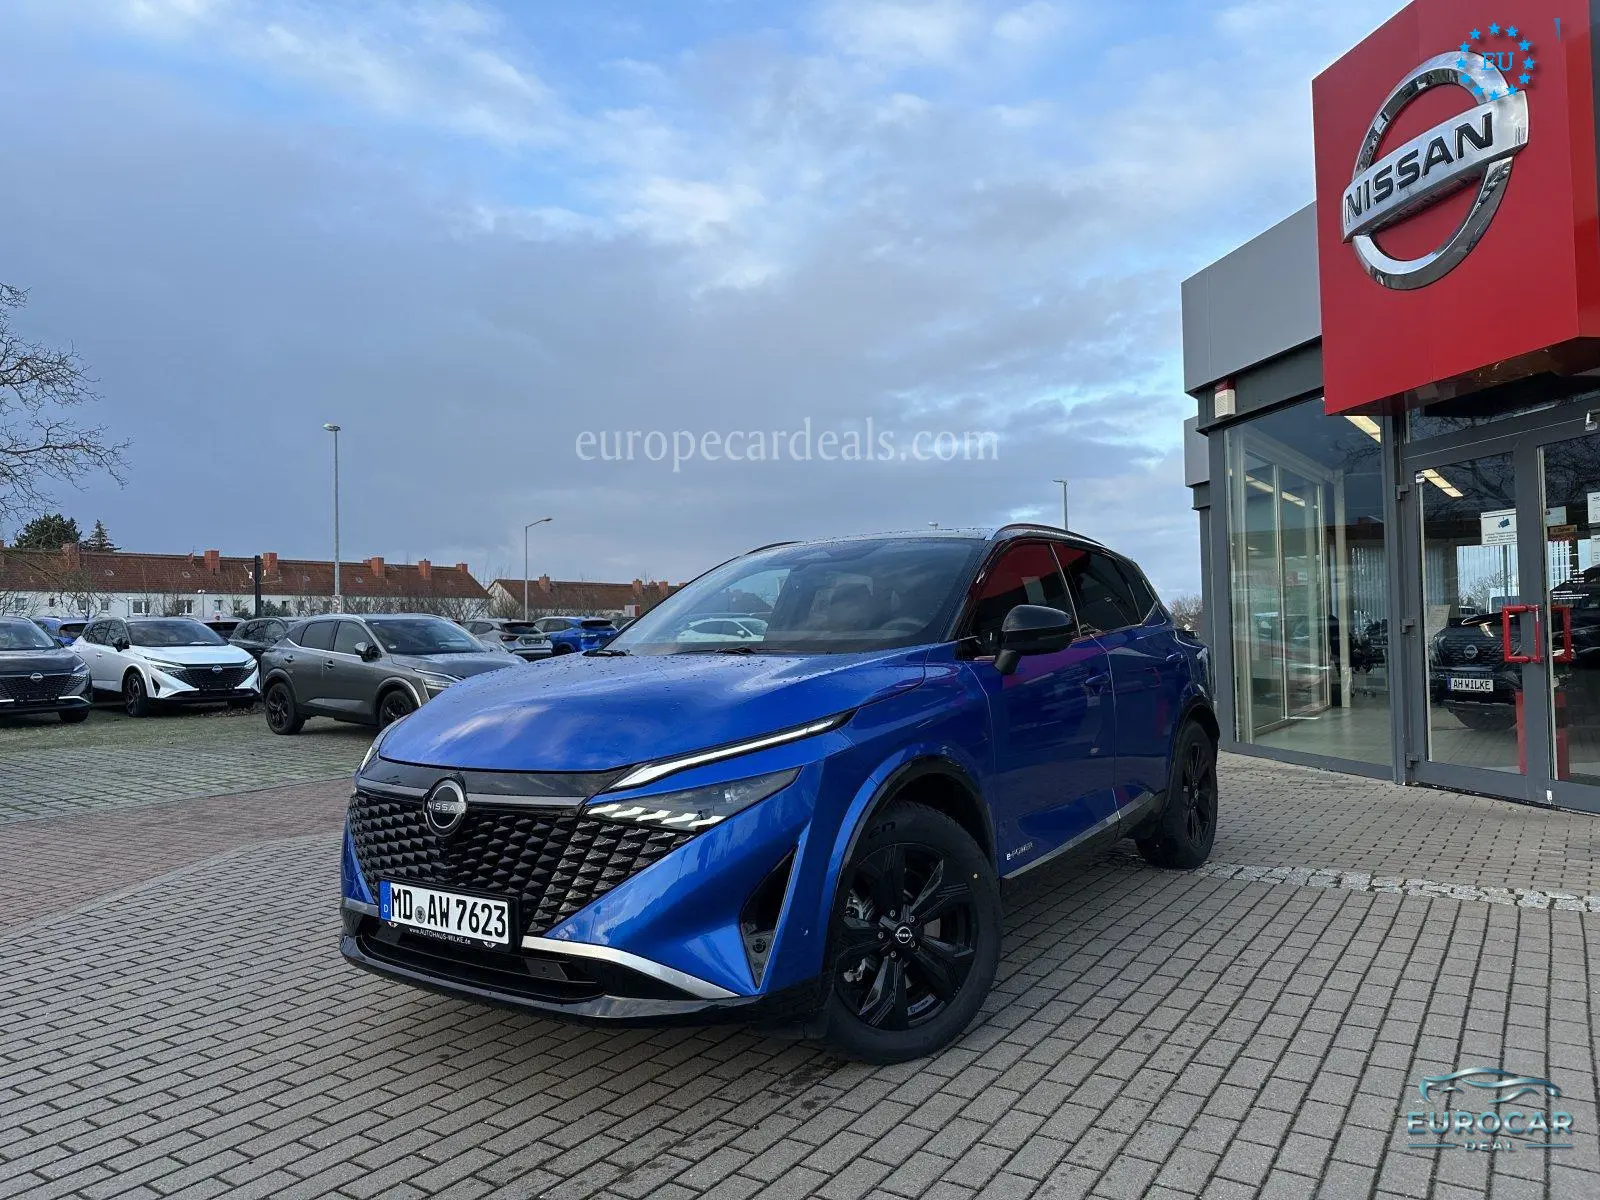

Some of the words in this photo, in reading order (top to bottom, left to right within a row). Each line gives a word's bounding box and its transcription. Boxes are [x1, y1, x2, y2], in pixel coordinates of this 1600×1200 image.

[1344, 112, 1494, 226] NISSAN
[1453, 679, 1464, 689] AH
[1465, 680, 1491, 690] WILKE
[427, 801, 466, 812] NISSAN
[383, 903, 389, 913] D
[391, 887, 413, 920] MD
[427, 894, 450, 928] AW
[455, 898, 507, 938] 7623
